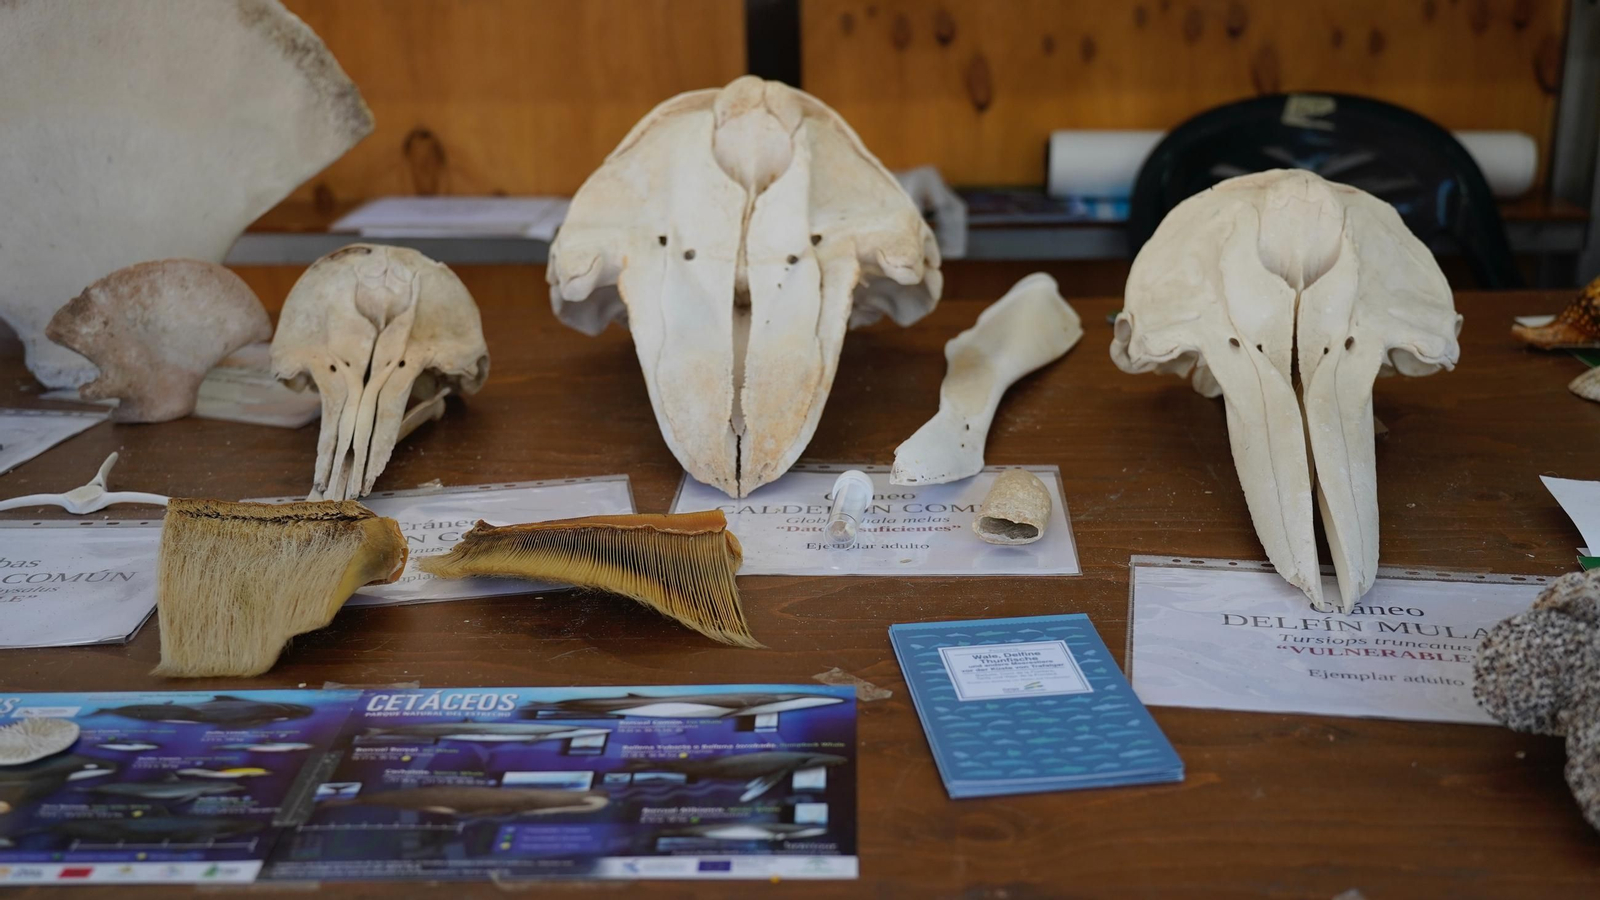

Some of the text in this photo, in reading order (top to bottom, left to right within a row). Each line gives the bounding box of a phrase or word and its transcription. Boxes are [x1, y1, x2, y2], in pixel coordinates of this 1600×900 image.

[715, 503, 982, 515] CALDEN COM
[902, 516, 951, 524] melas
[859, 525, 962, 533] suficientes”
[881, 542, 930, 550] adulto
[2, 569, 139, 585] COMÚN
[1221, 613, 1363, 632] DELFÍN
[1279, 633, 1473, 651] Tursiops truncatus
[1308, 668, 1466, 687] Ejemplar adulto
[366, 690, 518, 711] CETÁCEOS
